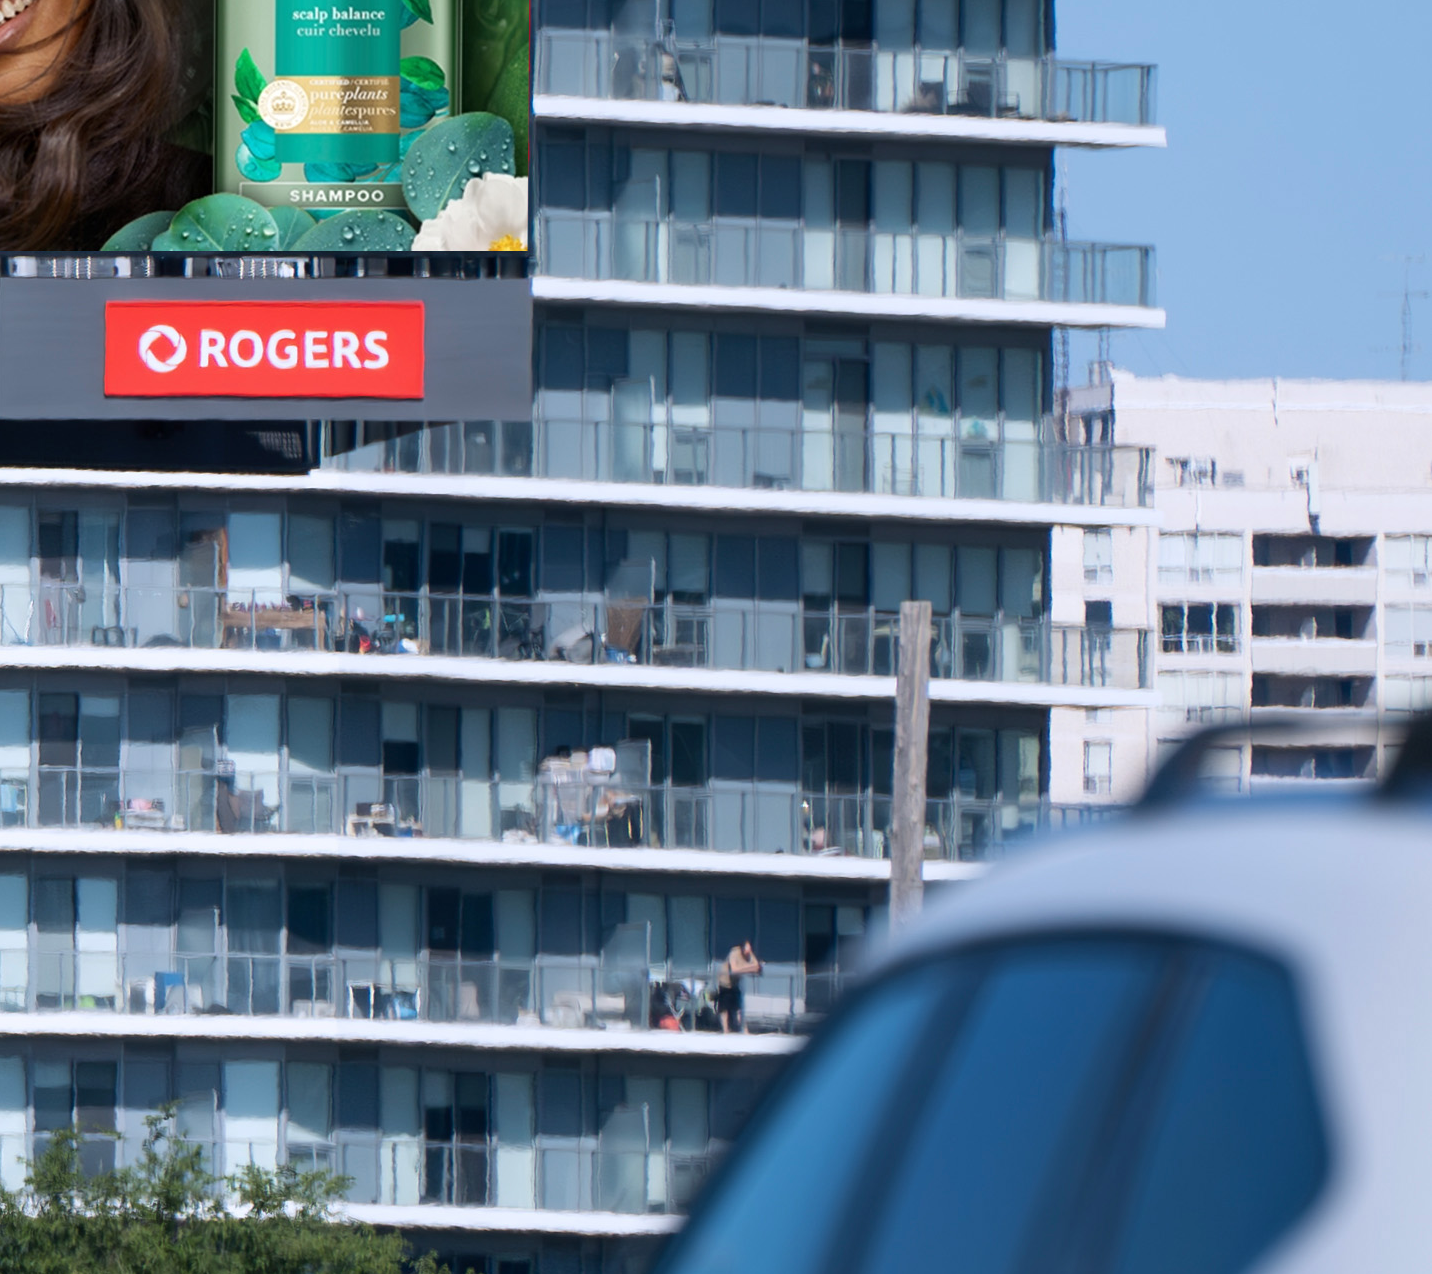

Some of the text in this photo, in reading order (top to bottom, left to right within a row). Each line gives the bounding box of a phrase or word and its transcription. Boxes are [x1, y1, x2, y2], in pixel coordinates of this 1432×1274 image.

[292, 7, 385, 24] scalp balance
[296, 24, 381, 36] cuir chevelu
[290, 189, 384, 202] SHAMPOO
[199, 329, 389, 370] ROGERS
